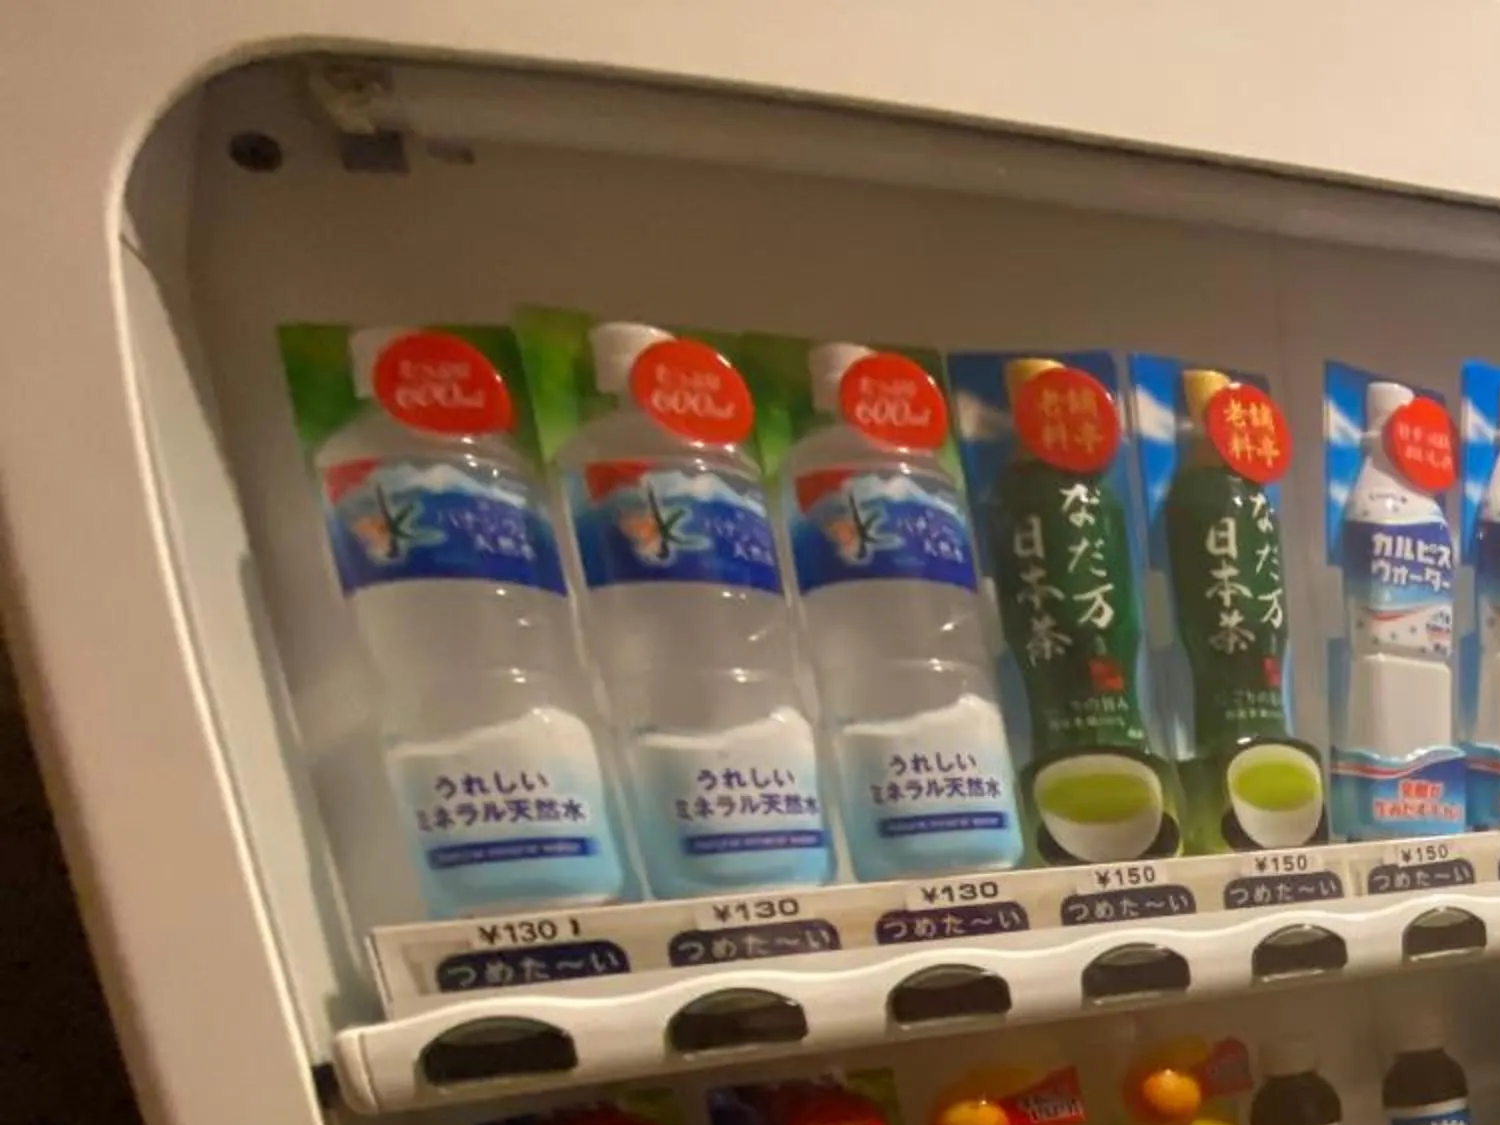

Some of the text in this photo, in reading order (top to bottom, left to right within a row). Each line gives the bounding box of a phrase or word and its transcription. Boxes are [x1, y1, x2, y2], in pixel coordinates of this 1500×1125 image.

[1060, 483, 1115, 629] なだ万
[1249, 492, 1284, 629] なだ万
[1371, 531, 1451, 569] カルピス
[1013, 514, 1072, 668] 日本茶
[1205, 517, 1256, 655] 日本茶
[696, 766, 796, 791] うれしい
[888, 752, 978, 777] うれしい
[435, 770, 551, 800] うれしい
[869, 777, 1002, 806] ミネラル天然水
[415, 798, 588, 833] ミネラル天然水
[675, 792, 821, 821] ミネラル天然水
[1254, 854, 1309, 874] ¥150
[1400, 843, 1449, 863] ¥150
[1095, 865, 1157, 889] ¥150
[920, 881, 1000, 905] ¥130
[712, 898, 799, 923] ¥130
[477, 918, 558, 946] ¥130
